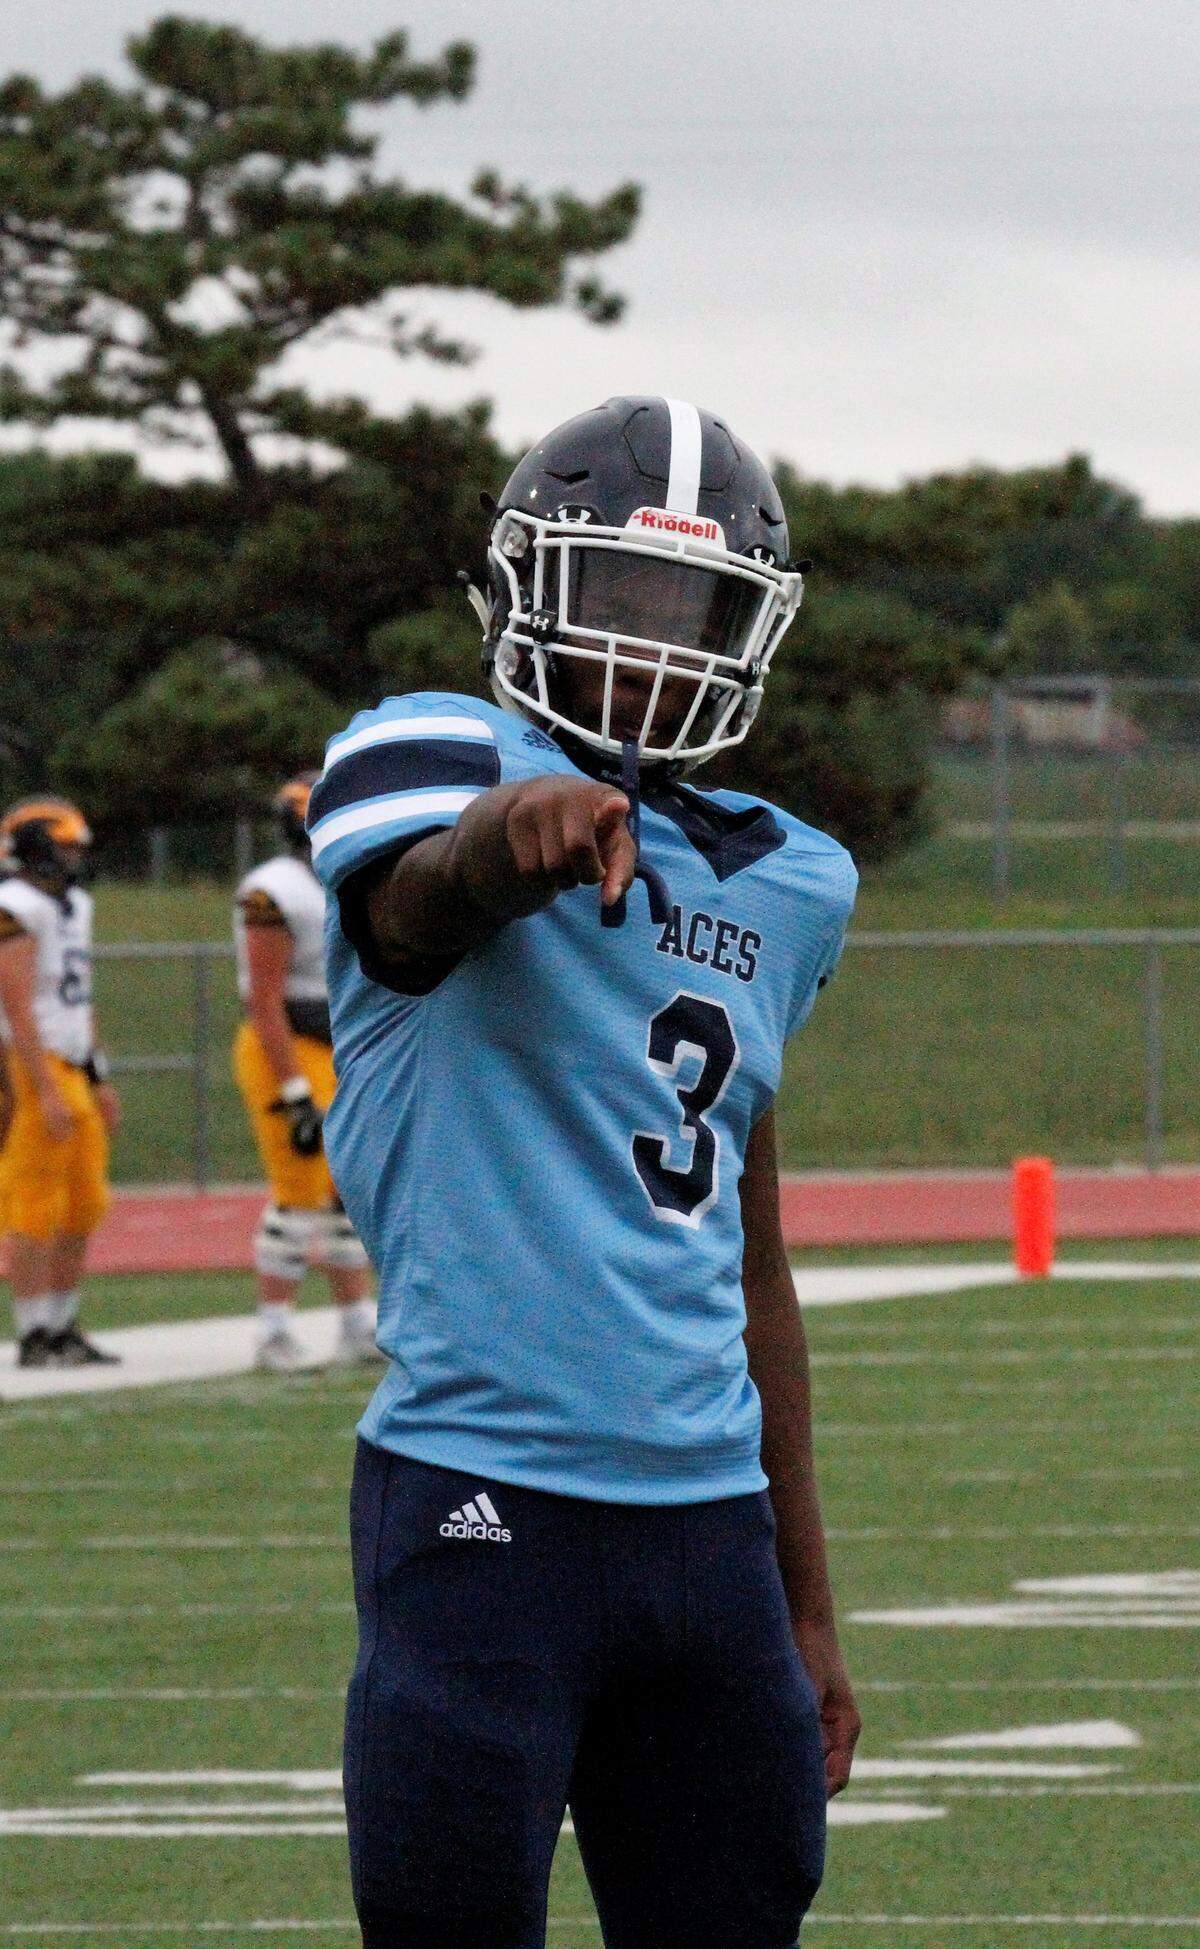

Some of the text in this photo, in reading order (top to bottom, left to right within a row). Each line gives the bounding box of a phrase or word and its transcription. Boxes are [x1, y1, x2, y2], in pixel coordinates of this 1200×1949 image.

[641, 510, 718, 540] Riddell
[656, 903, 761, 983] ACES
[631, 989, 740, 1229] 3
[439, 1520, 512, 1542] adidas
